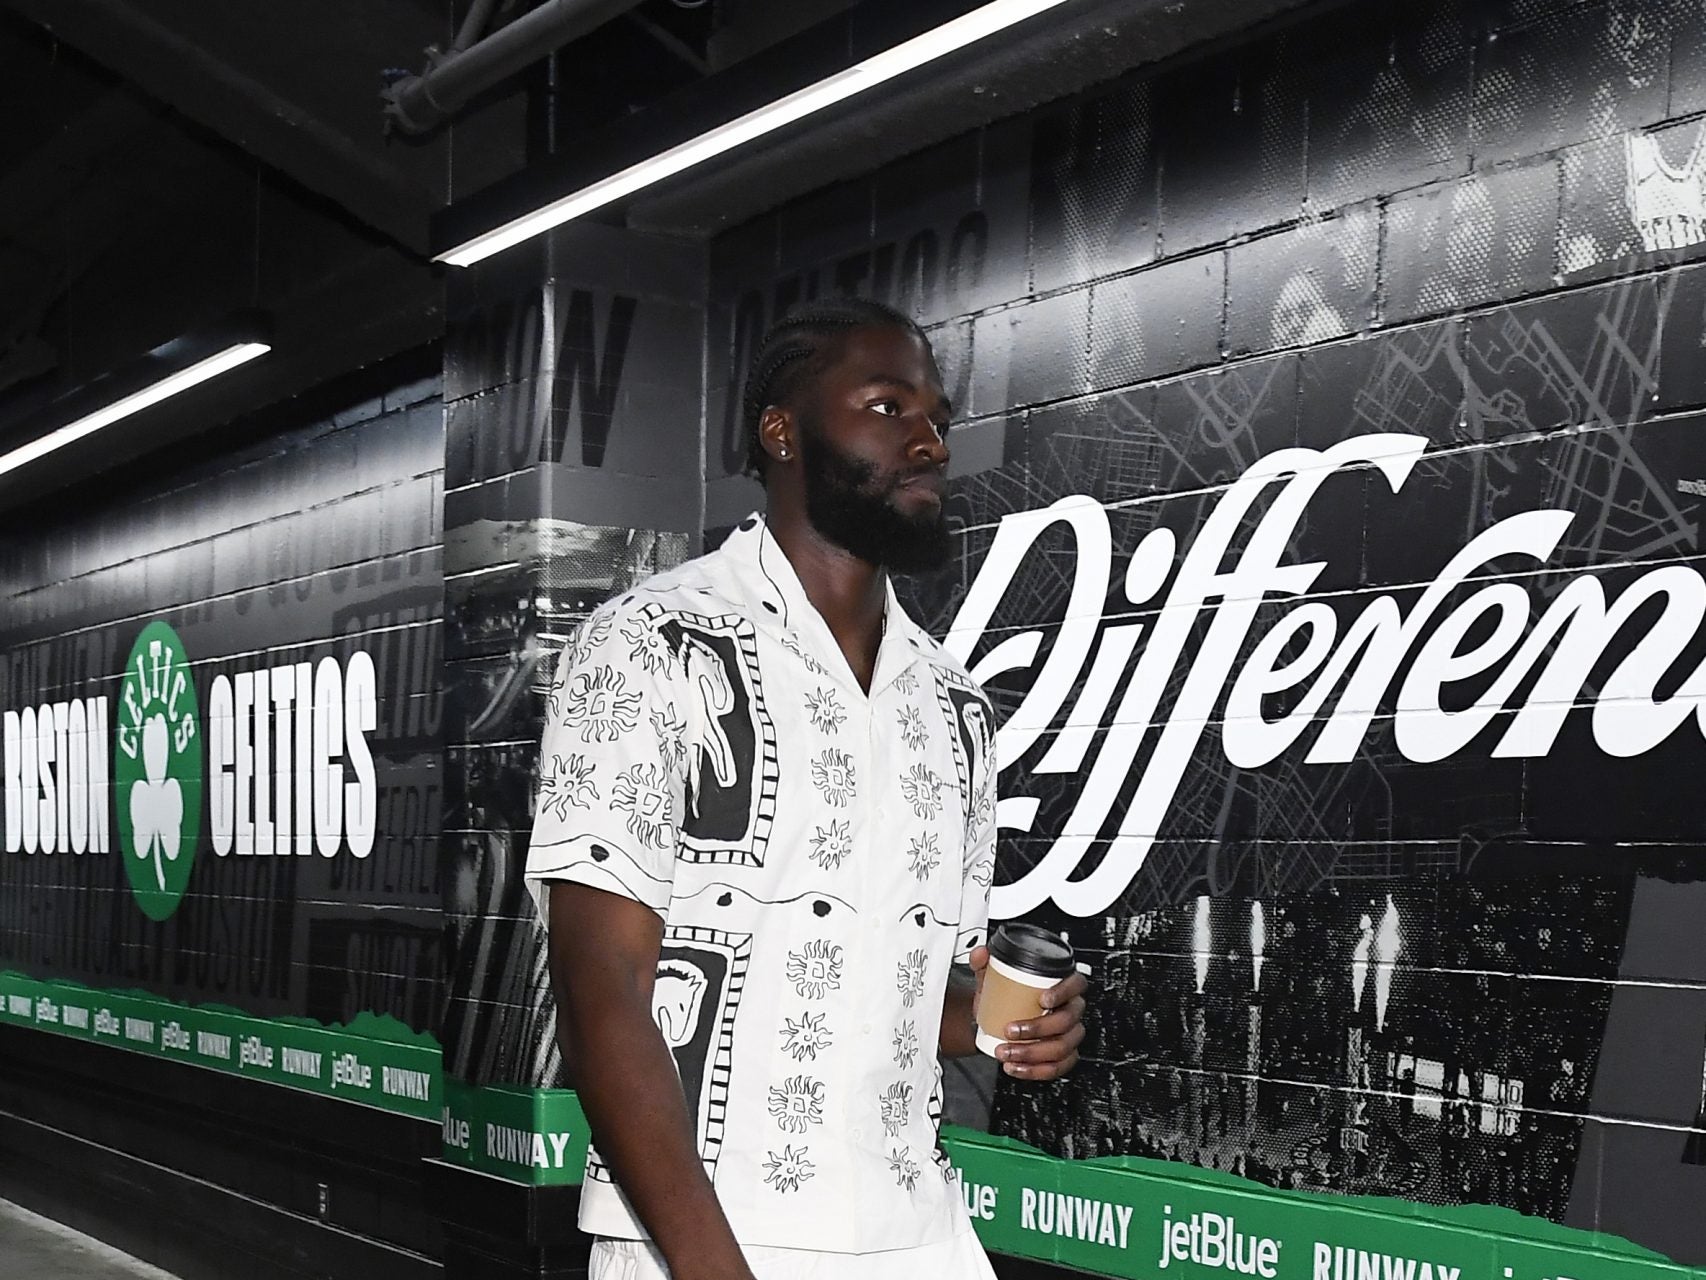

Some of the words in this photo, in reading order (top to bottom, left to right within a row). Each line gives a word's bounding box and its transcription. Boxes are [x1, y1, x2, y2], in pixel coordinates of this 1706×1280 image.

[119, 640, 196, 759] CELTICS
[942, 433, 1706, 920] Differen
[4, 696, 109, 854] BOSTON
[209, 650, 377, 858] CELTICS
[331, 1051, 371, 1089] jetBlue
[382, 1066, 430, 1101] RUNWAY
[487, 1123, 570, 1168] RUNWAY
[1021, 1187, 1133, 1249] RUNWAY
[1159, 1205, 1280, 1279] jetBlue
